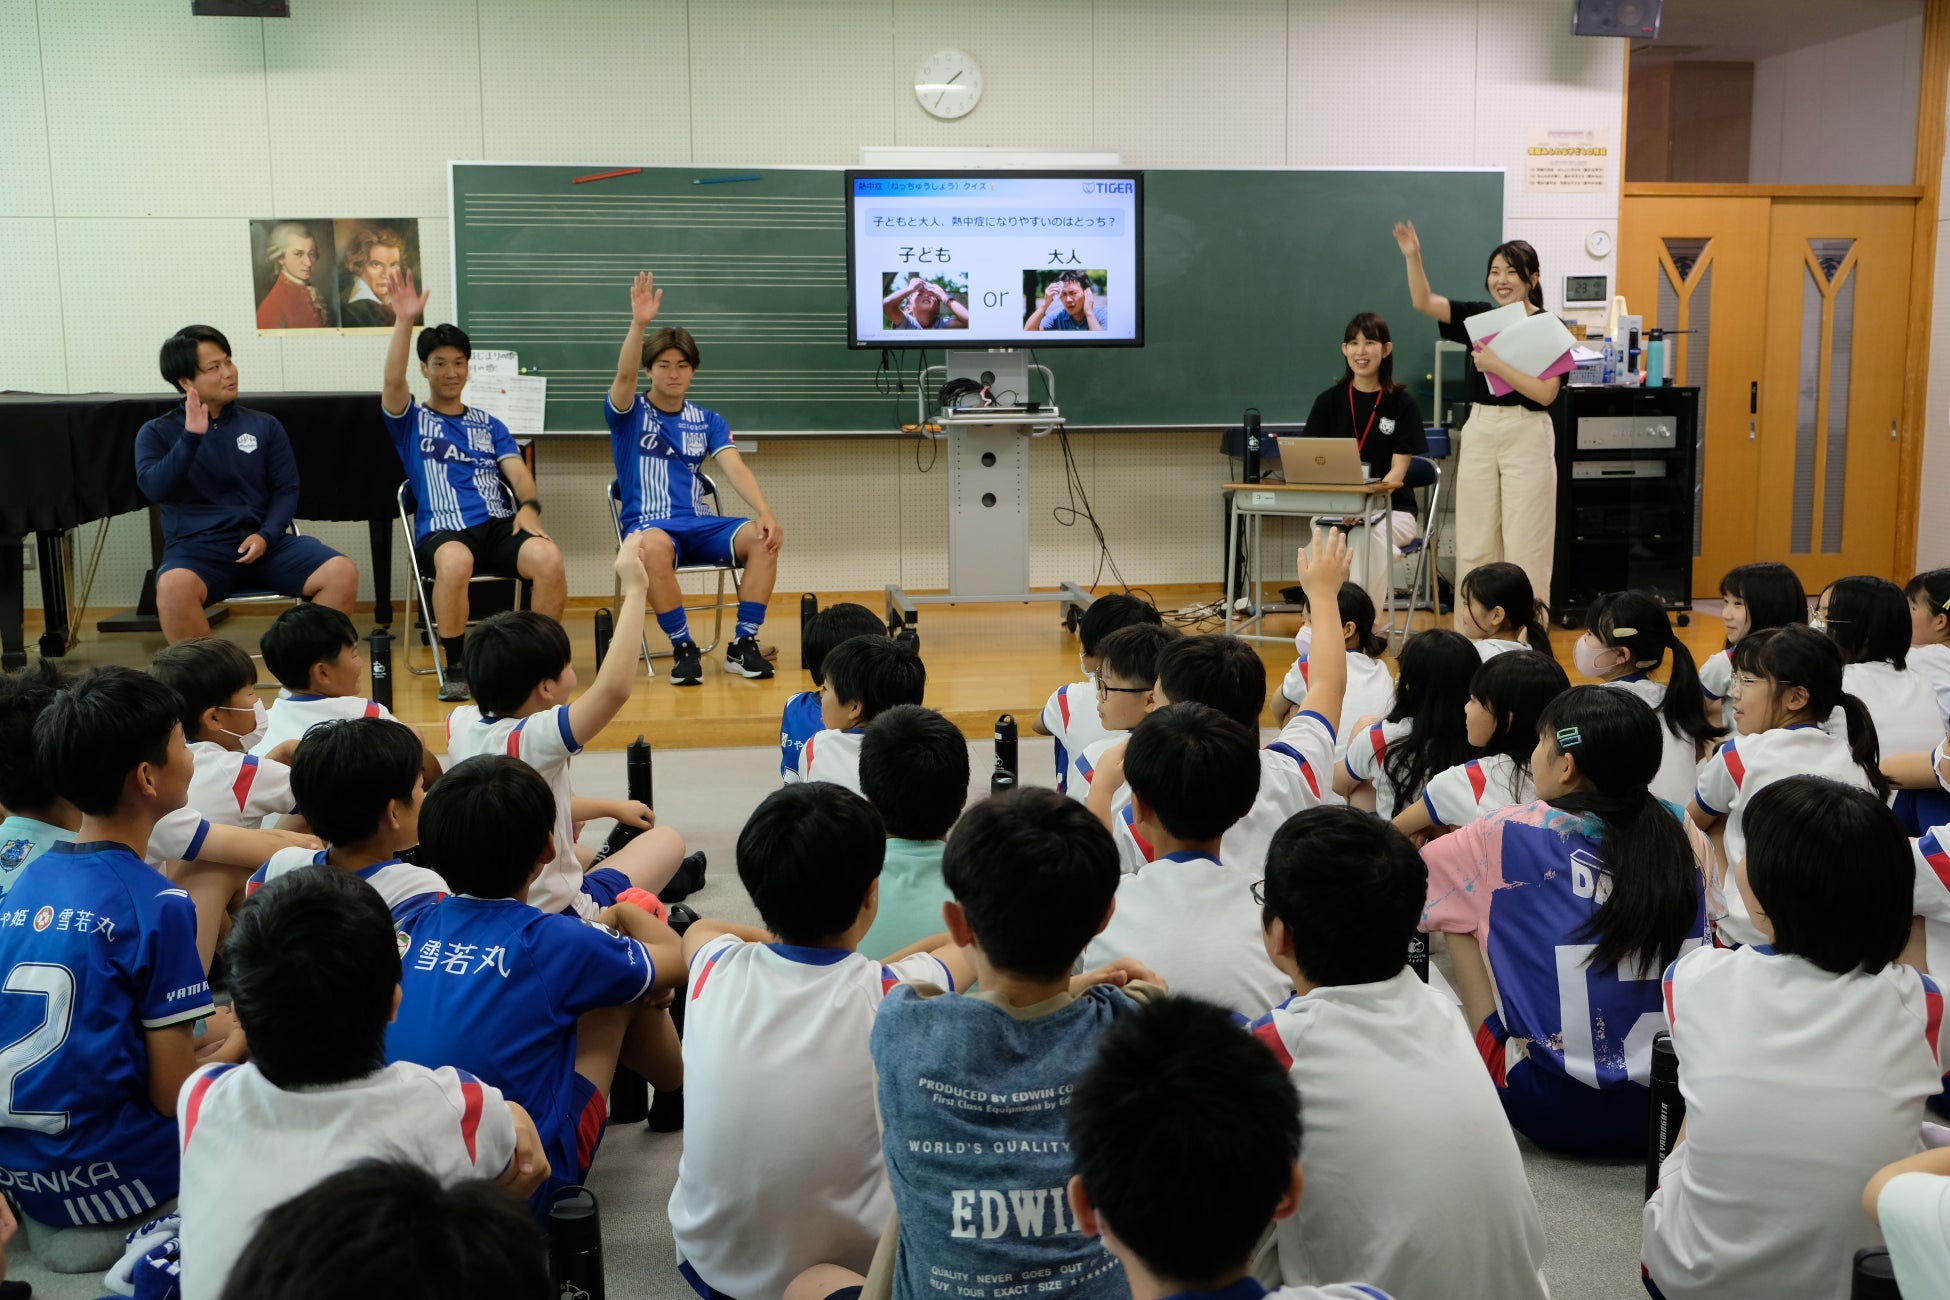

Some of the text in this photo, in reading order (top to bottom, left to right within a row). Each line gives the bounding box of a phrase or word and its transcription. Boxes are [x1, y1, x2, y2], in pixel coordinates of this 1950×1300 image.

[1096, 183, 1133, 194] TIGER
[899, 247, 951, 263] 子ども
[1048, 249, 1082, 265] 大人
[983, 290, 1009, 308] or
[56, 908, 116, 943] 雪若丸
[414, 939, 511, 978] 雪若丸
[918, 1078, 987, 1102] PRODUCED
[991, 1094, 1007, 1103] BY
[1012, 1088, 1054, 1103] EDWIN
[932, 1093, 955, 1106] First
[957, 1099, 983, 1112] Class
[986, 1101, 1042, 1115] Equipment
[1044, 1099, 1057, 1110] by
[1659, 1102, 1668, 1151] YAMAGATA
[908, 1140, 1071, 1155] WORLD'S QUALITY
[951, 1187, 1081, 1239] EDWI
[931, 1265, 969, 1282] QUALITY
[976, 1273, 1013, 1284] NEVER
[1021, 1268, 1052, 1280] GOES
[1060, 1262, 1083, 1274] OUT
[930, 1279, 1063, 1298] BUY YOUR EXACT SIZE
